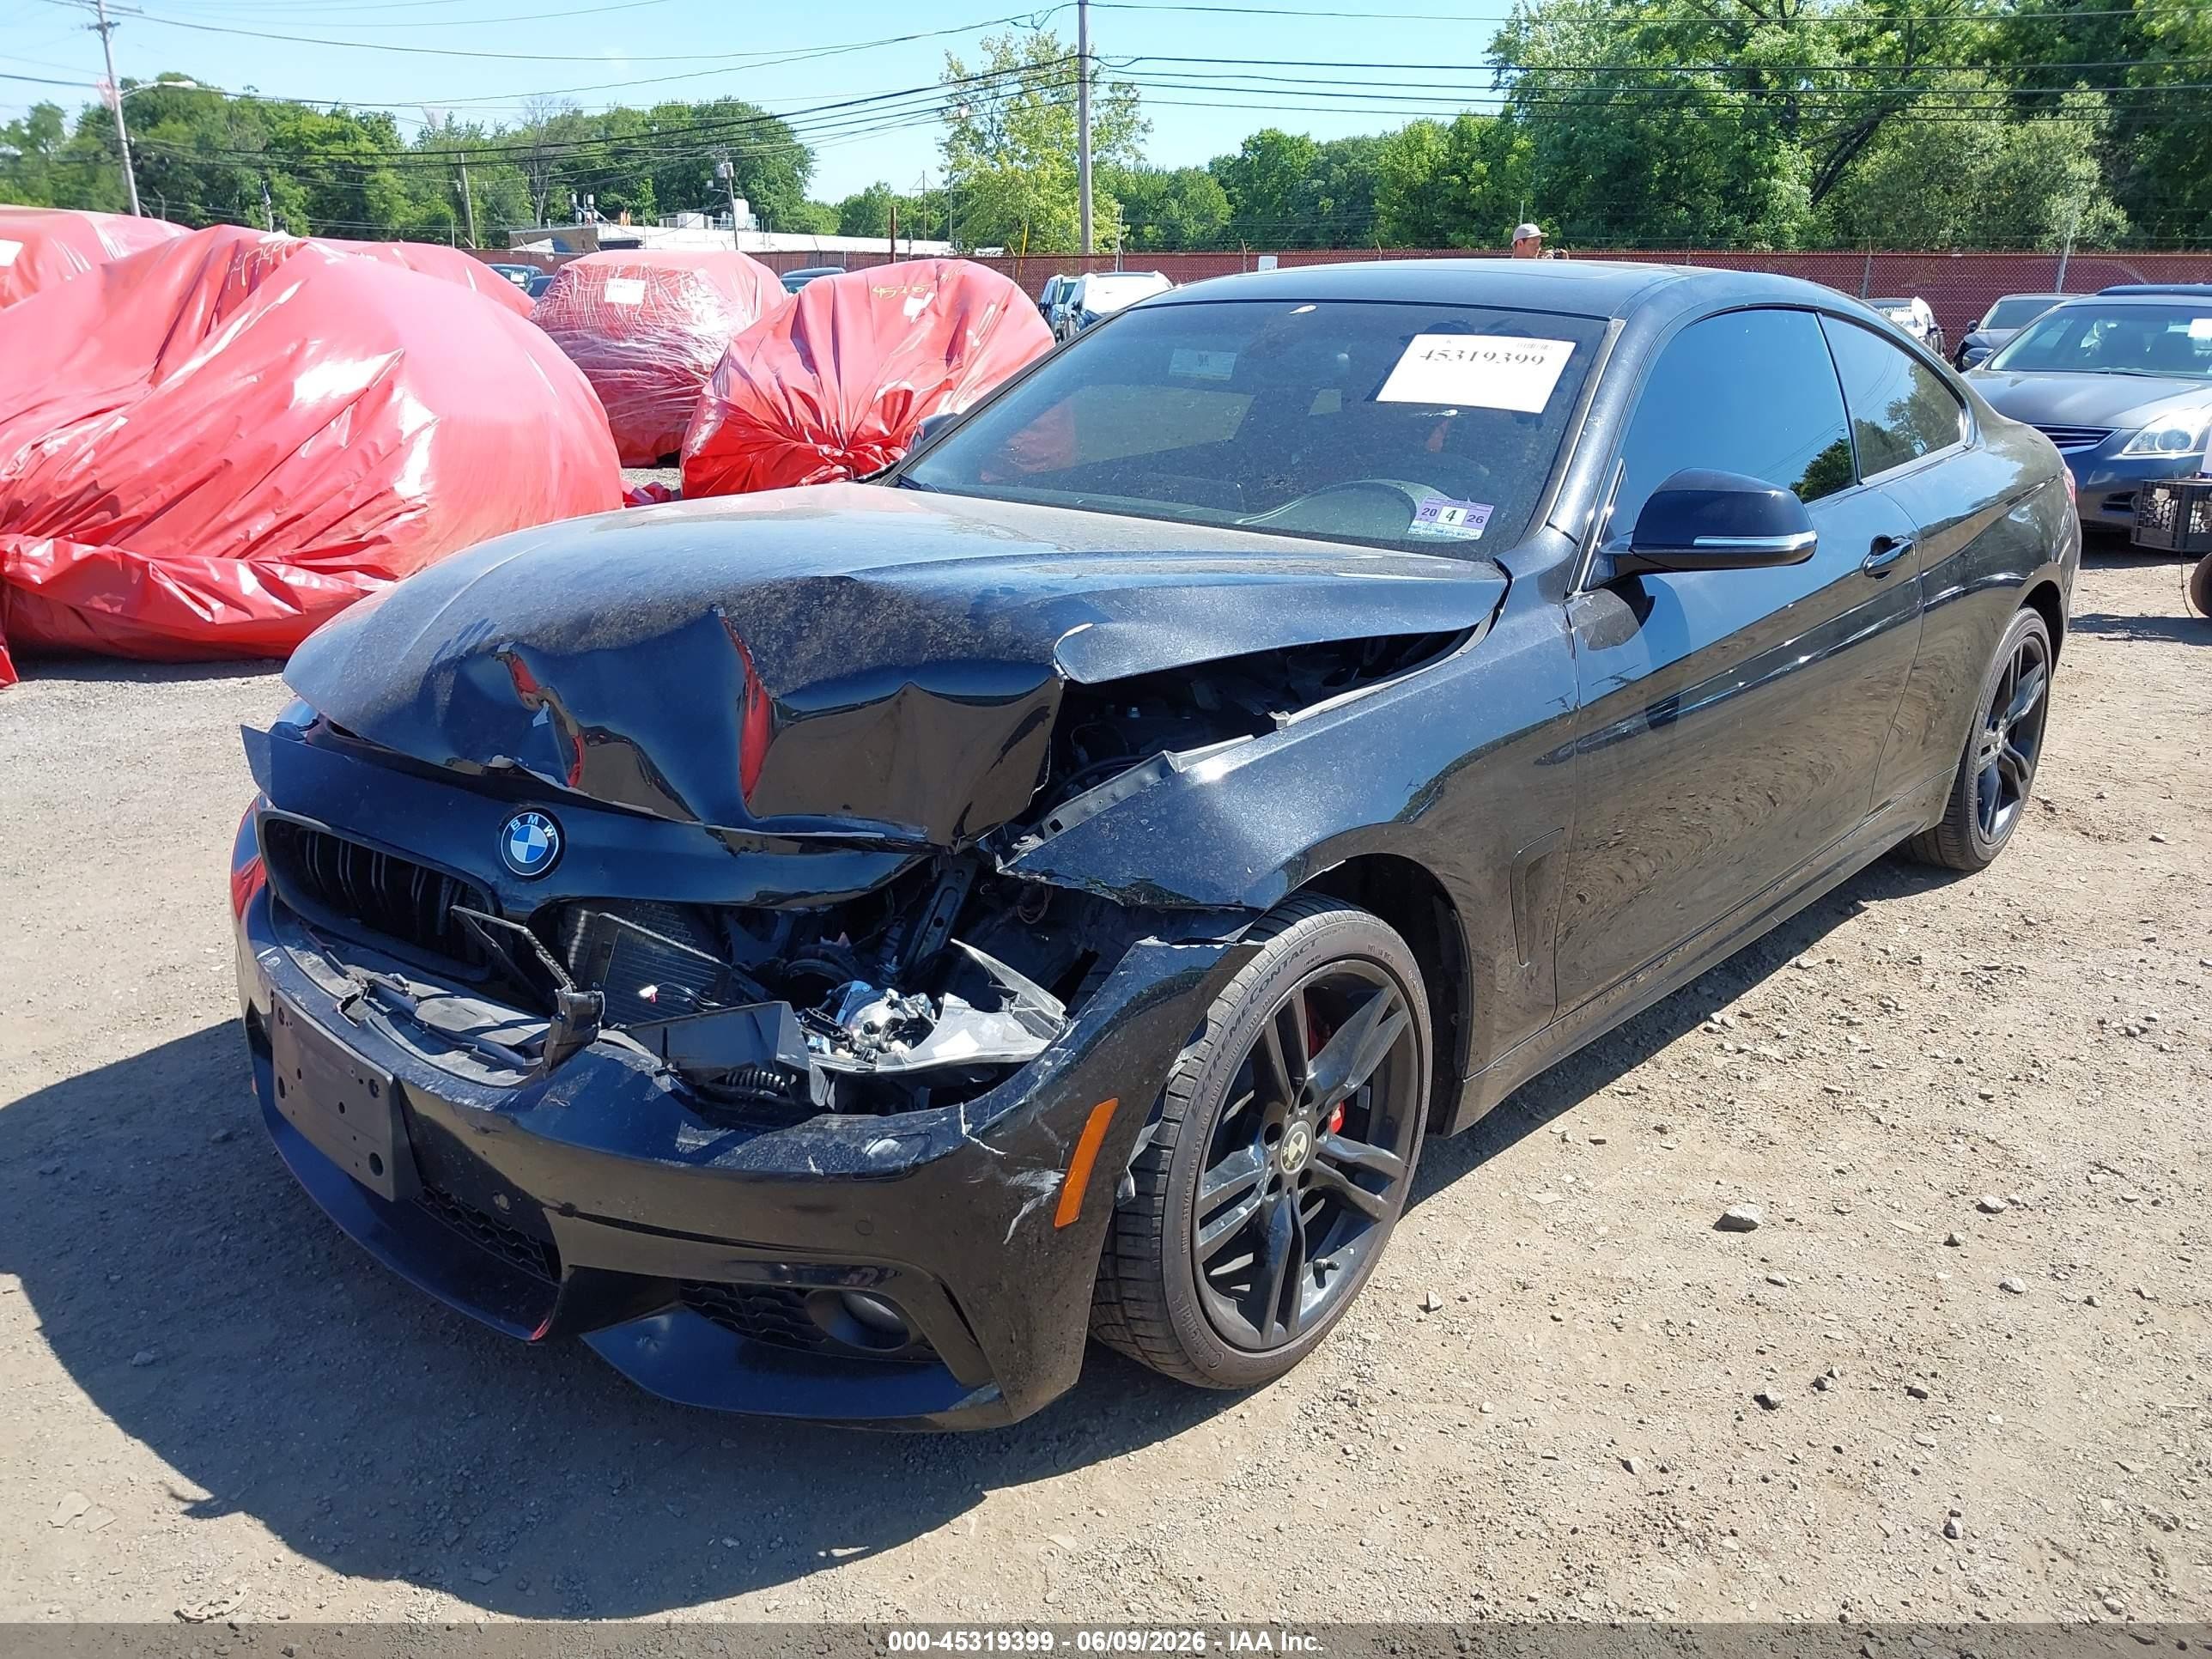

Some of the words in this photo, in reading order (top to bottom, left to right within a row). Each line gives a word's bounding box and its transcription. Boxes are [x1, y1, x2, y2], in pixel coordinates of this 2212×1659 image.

[1420, 349, 1546, 366] 45319399
[1421, 507, 1438, 517] 20
[1445, 509, 1457, 522] 4
[1467, 514, 1485, 524] 26
[510, 814, 555, 838] BMW
